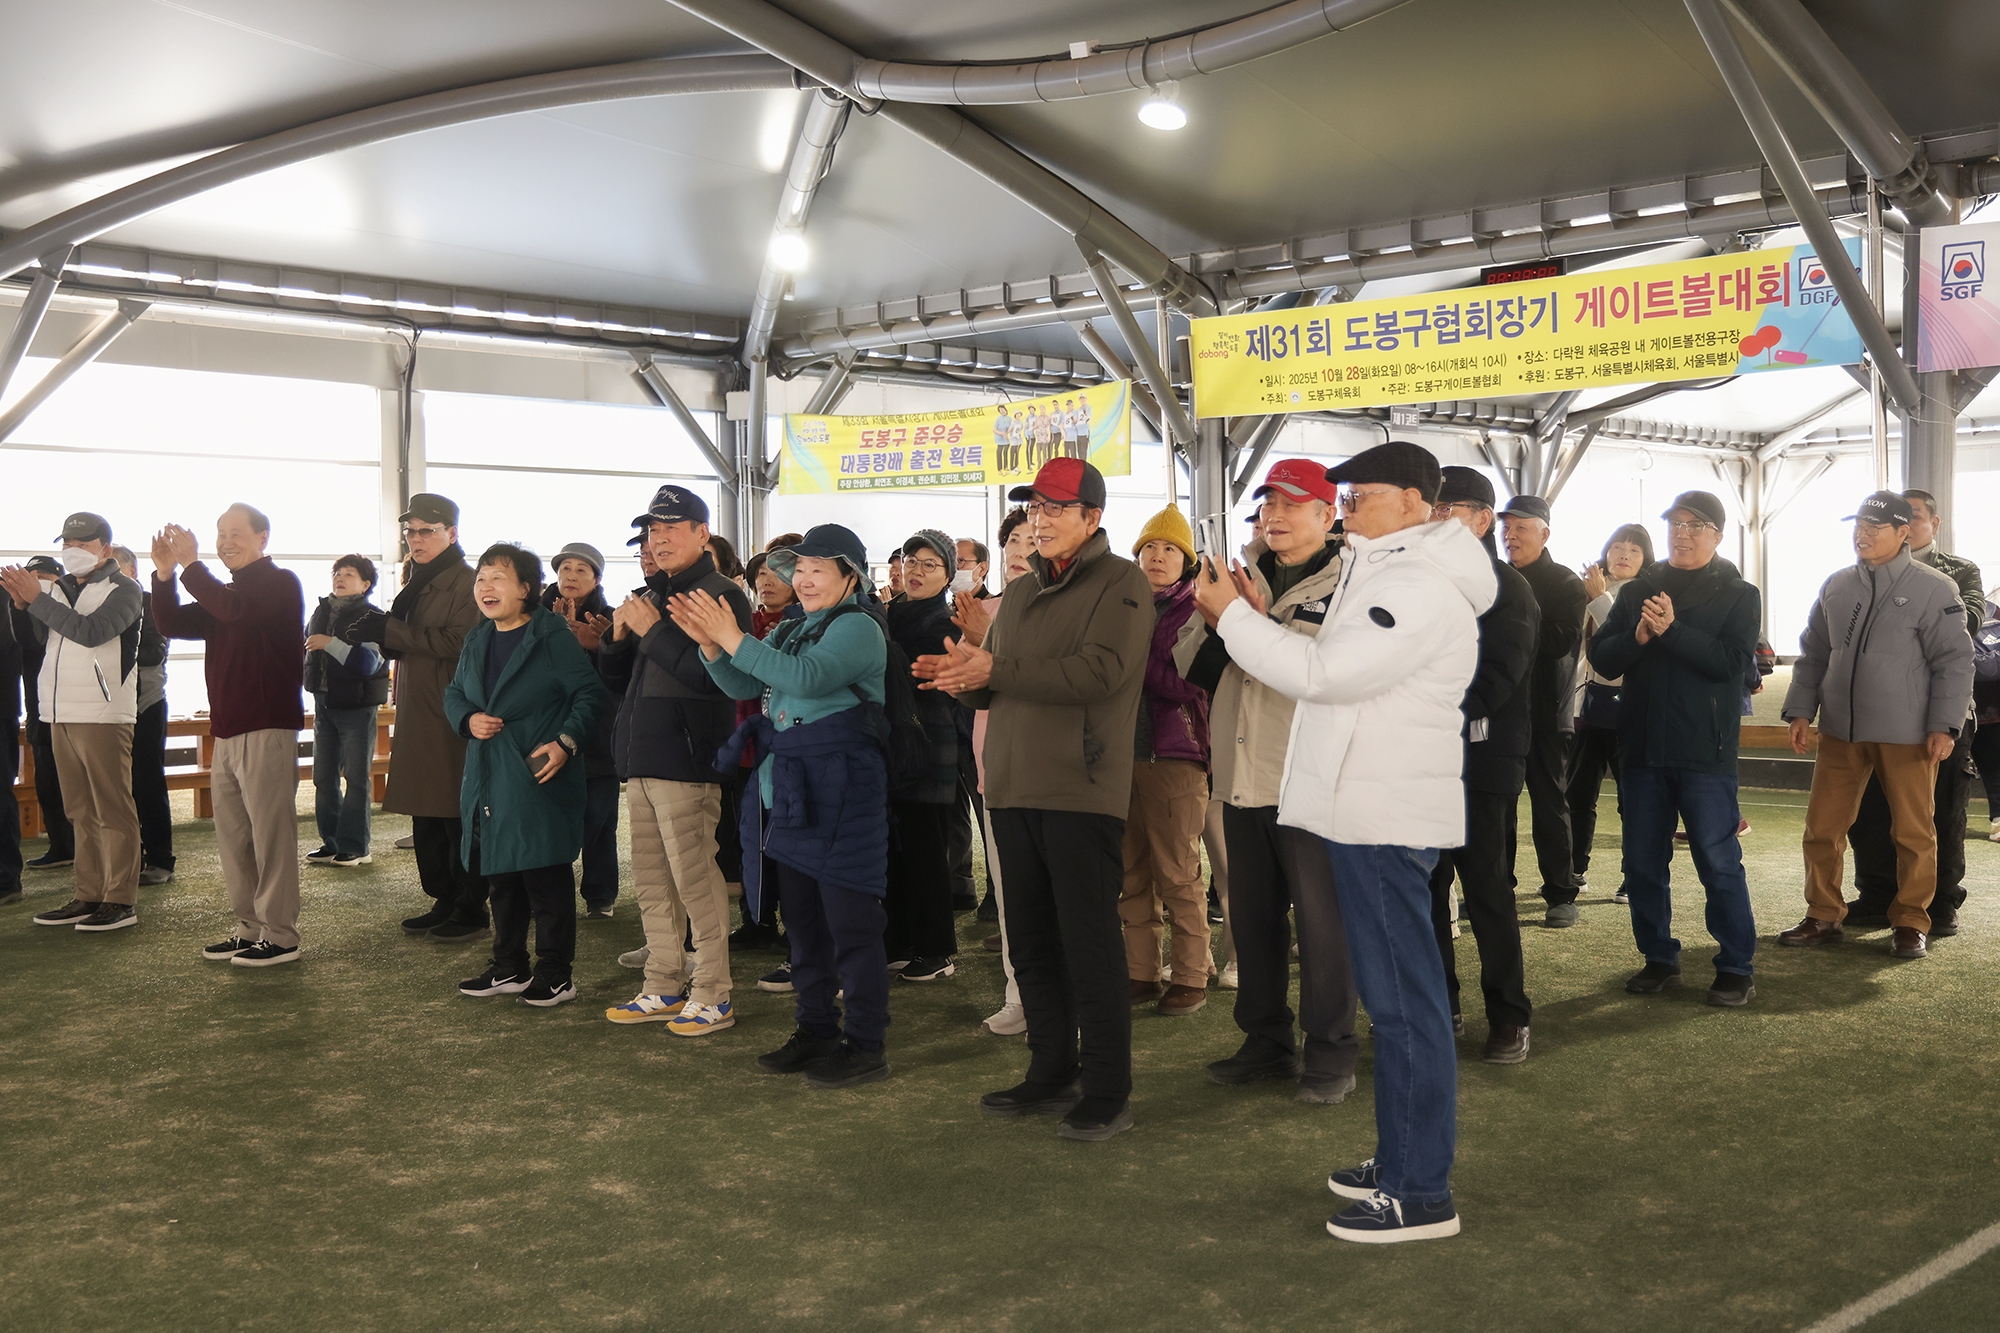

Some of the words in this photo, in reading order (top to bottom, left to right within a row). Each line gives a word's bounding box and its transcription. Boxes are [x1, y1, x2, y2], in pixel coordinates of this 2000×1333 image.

[1800, 289, 1835, 306] DGF
[1940, 283, 1983, 301] SGF
[1245, 318, 1332, 362] 제31회
[1344, 291, 1558, 352] 도봉구협회장기
[1574, 262, 1790, 328] 게이트볼대회
[1198, 349, 1229, 359] dobong
[1524, 351, 1549, 365] 장소:
[1553, 345, 1584, 362] 다락원
[1588, 340, 1631, 358] 체육공원
[1635, 338, 1646, 353] 내
[1650, 328, 1741, 351] 게이트볼전용구장
[1264, 375, 1285, 388] 일시:
[1288, 371, 1318, 385] 2025년
[1321, 368, 1343, 383] 10월
[1346, 364, 1402, 381] 28일(화요일)
[1404, 356, 1478, 375] 08~16시(개회식
[1482, 353, 1508, 368] 10시)
[1524, 369, 1550, 383] 후원:
[1554, 366, 1588, 382] 도봉구,
[1591, 357, 1679, 378] 서울특별시체육회,
[1683, 350, 1740, 369] 서울특별시
[1266, 393, 1287, 405] 주최:
[1307, 386, 1361, 402] 도봉구체육회
[1387, 382, 1411, 396] 주관:
[1414, 373, 1502, 394] 도봉구게이트볼협회
[858, 428, 907, 449] 도봉구
[913, 423, 964, 446] 준우승
[840, 451, 904, 474] 대통령배
[910, 449, 943, 470] 출전
[949, 445, 982, 467] 획득
[1844, 601, 1862, 648] DYNAFIT
